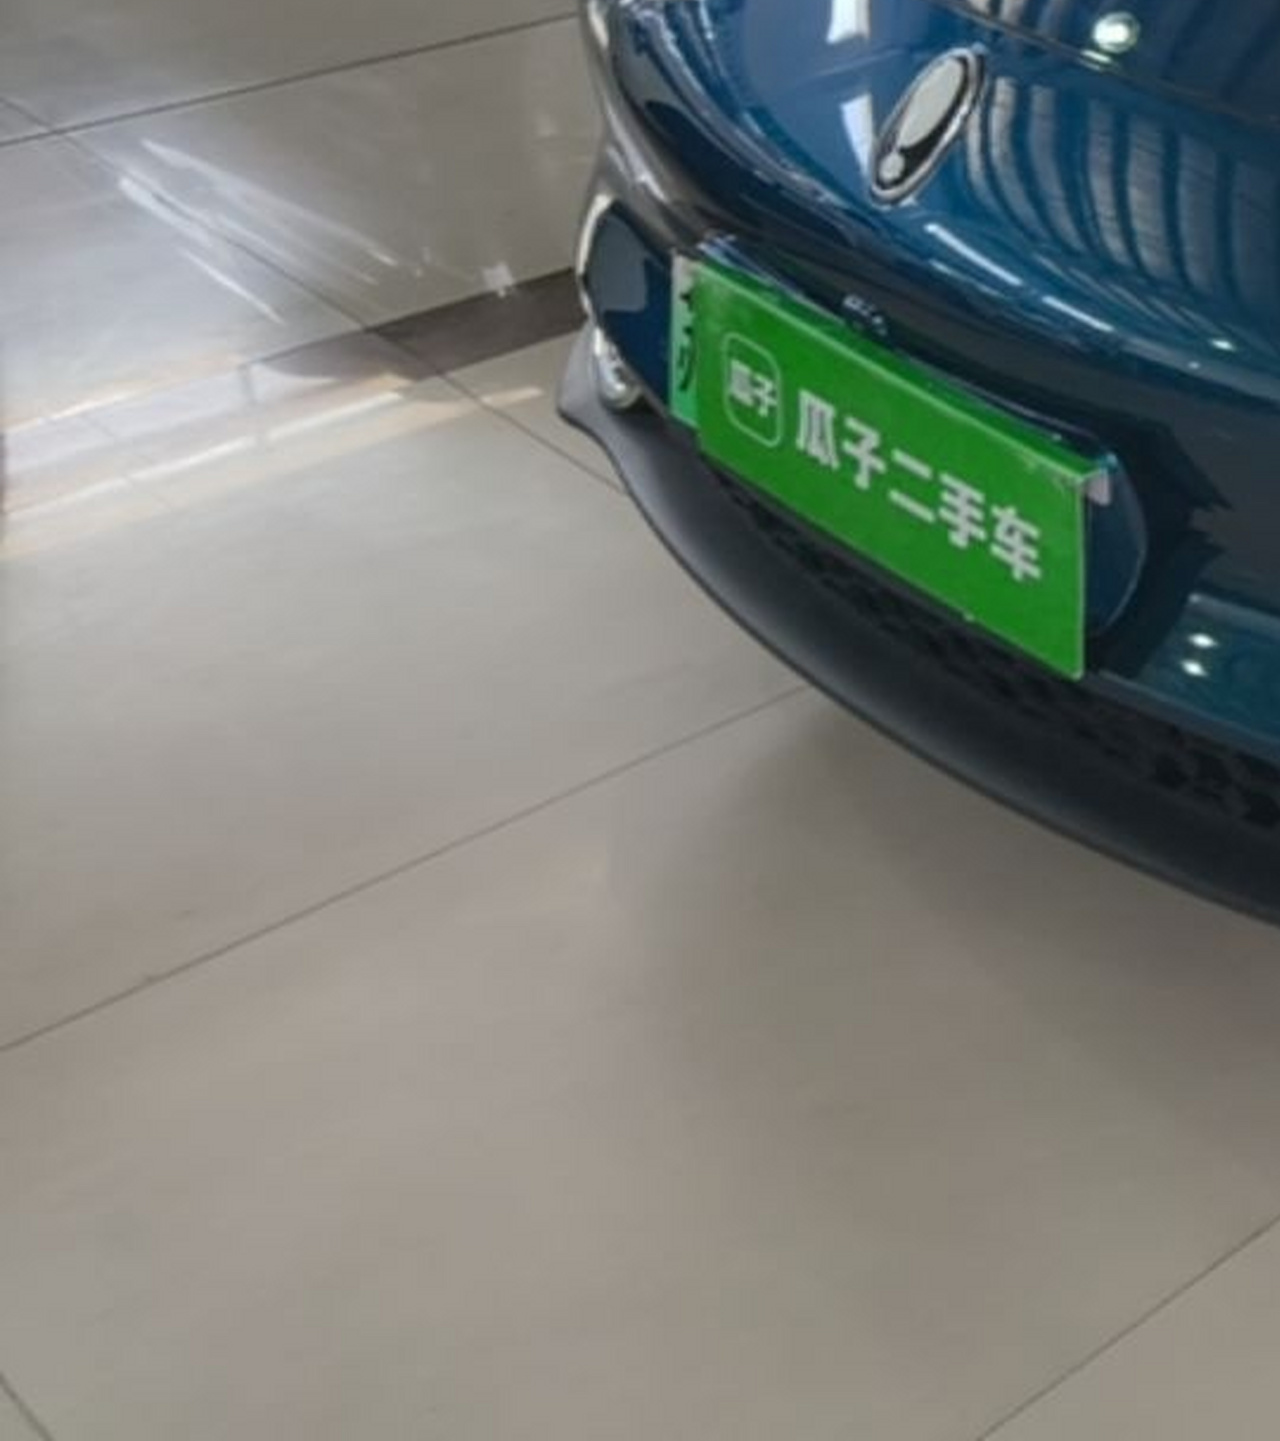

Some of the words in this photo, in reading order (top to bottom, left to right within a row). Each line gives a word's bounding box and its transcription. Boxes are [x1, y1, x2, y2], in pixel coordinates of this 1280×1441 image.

[797, 389, 1042, 582] 瓜子二手车
